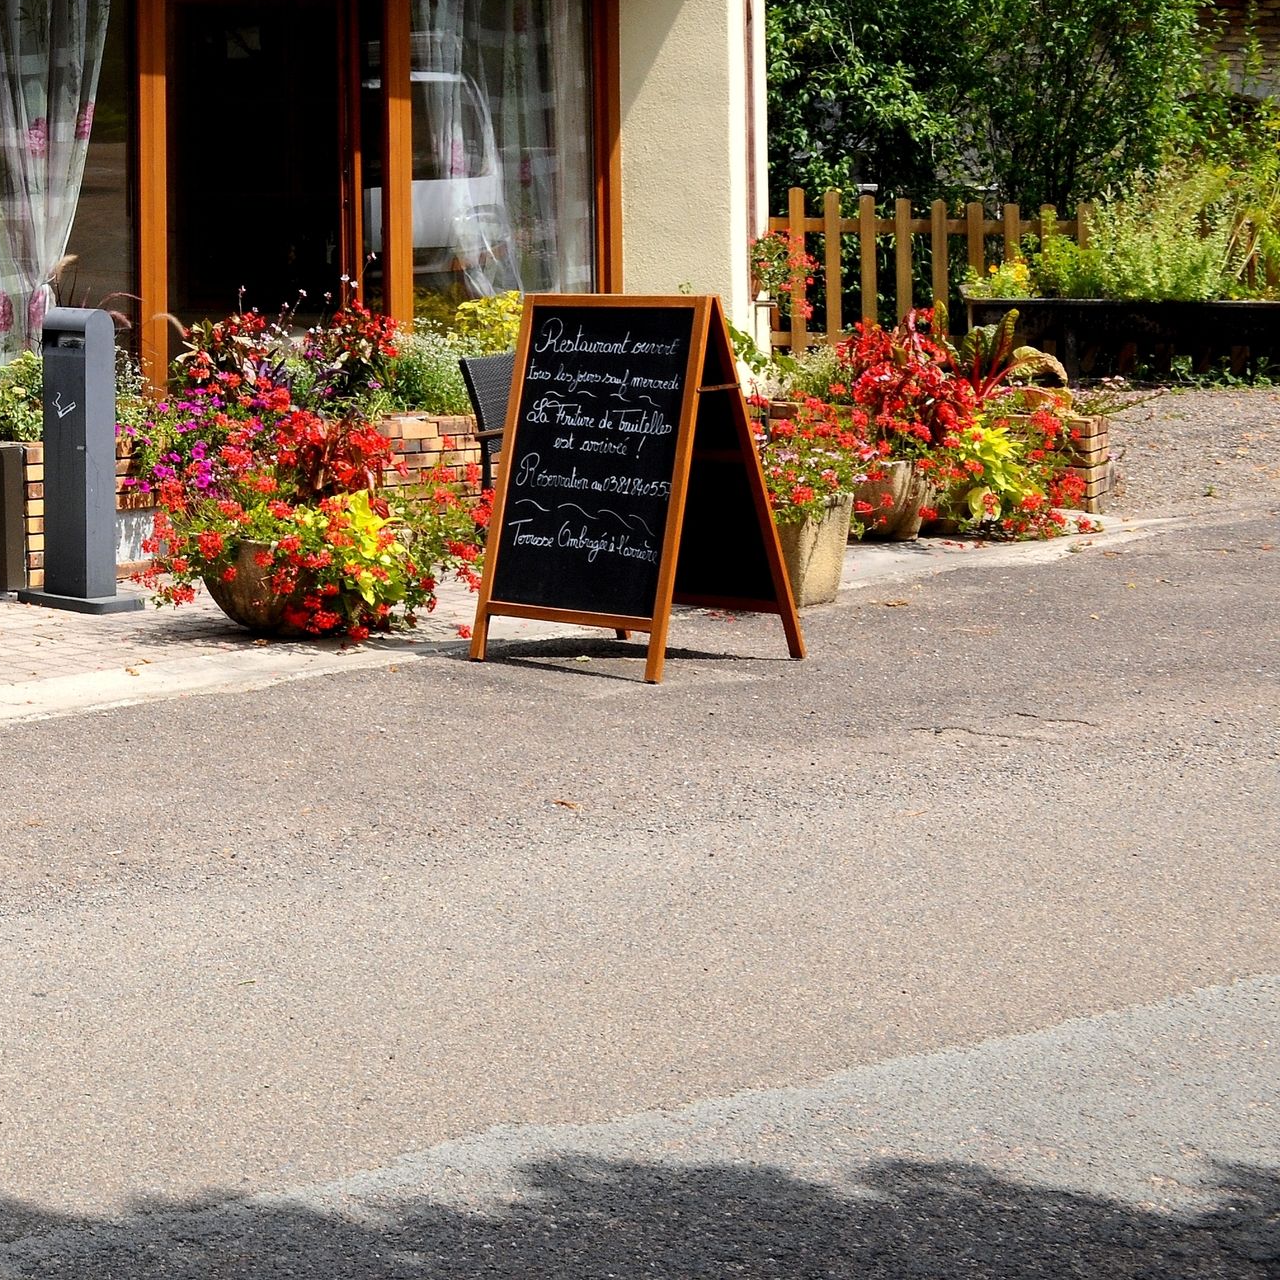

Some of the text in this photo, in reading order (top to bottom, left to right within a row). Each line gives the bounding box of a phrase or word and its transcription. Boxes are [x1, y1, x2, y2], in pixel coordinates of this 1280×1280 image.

[535, 317, 680, 355] Restaurant ouvert
[526, 358, 681, 395] tous les jours sauf mercredi
[526, 398, 550, 423] La
[598, 410, 613, 430] de
[553, 432, 575, 450] est
[636, 436, 646, 459] !
[515, 452, 589, 488] Réservation
[591, 480, 603, 492] au
[508, 518, 554, 547] Terrasse
[557, 520, 608, 563] Ombragée
